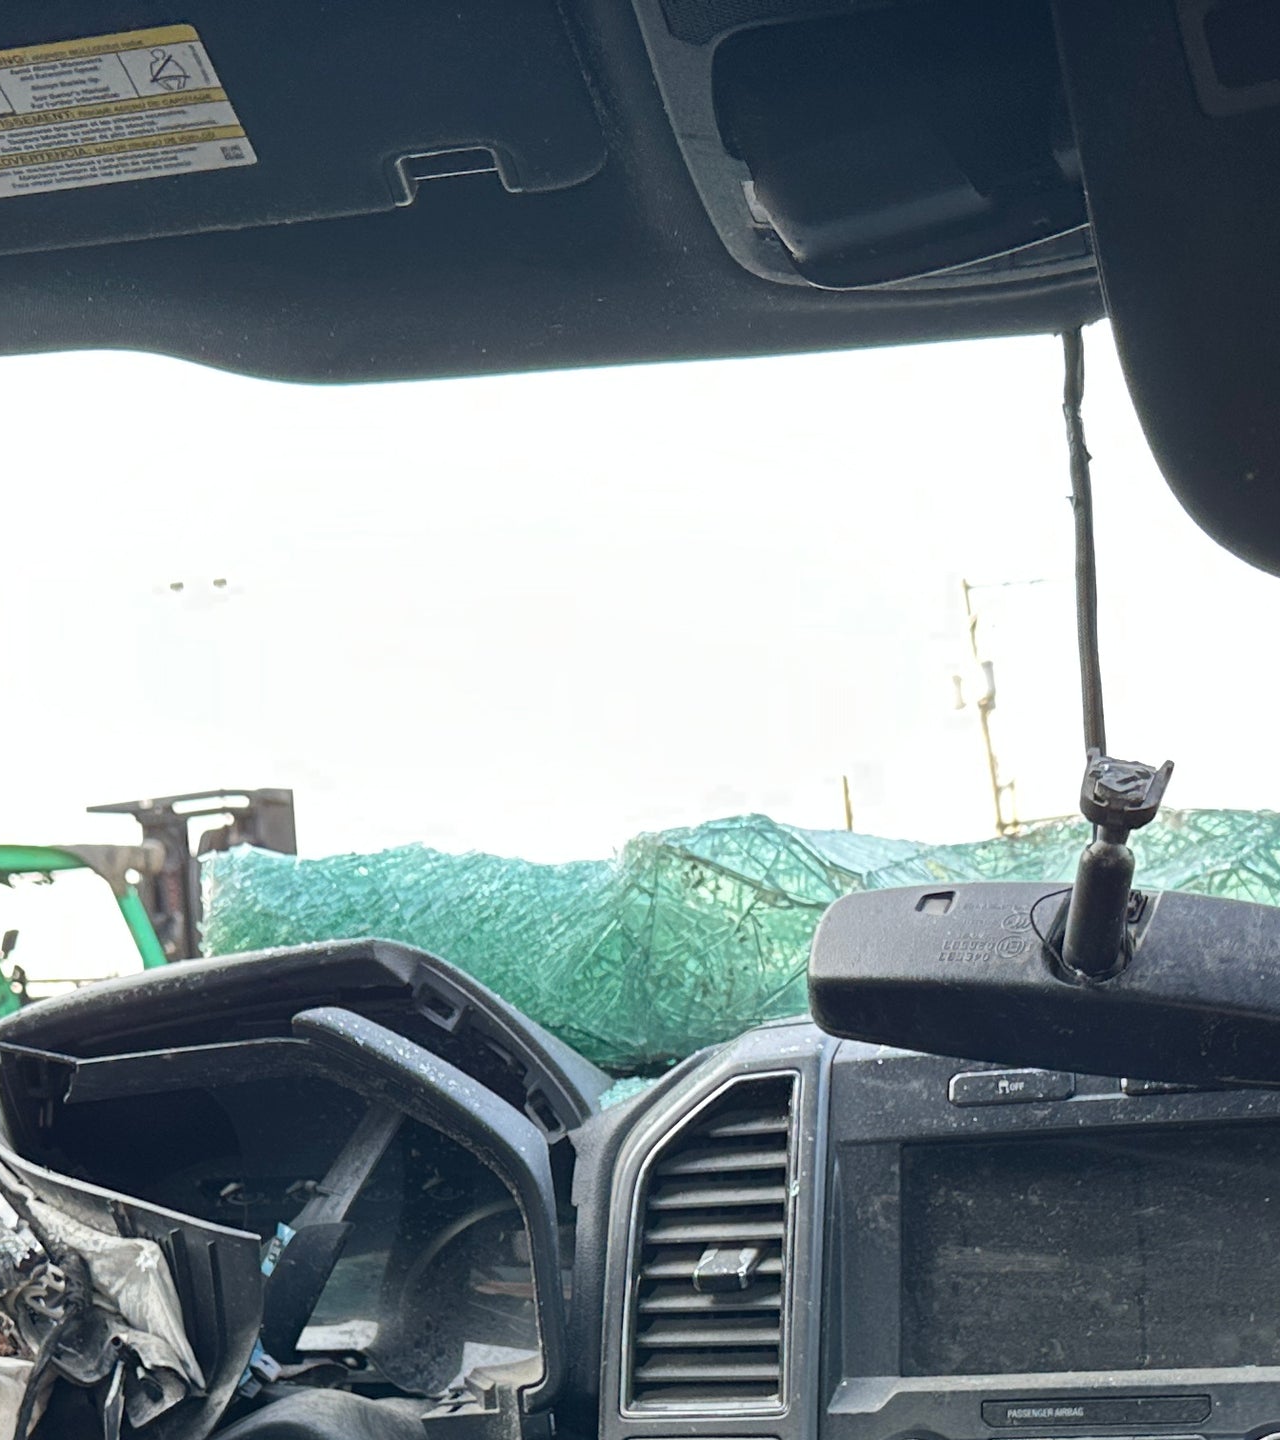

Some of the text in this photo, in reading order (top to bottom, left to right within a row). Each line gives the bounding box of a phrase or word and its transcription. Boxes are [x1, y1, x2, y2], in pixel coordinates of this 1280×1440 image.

[1010, 1082, 1025, 1092] OFF
[1007, 1407, 1084, 1418] PASSENGER AIRBAG
